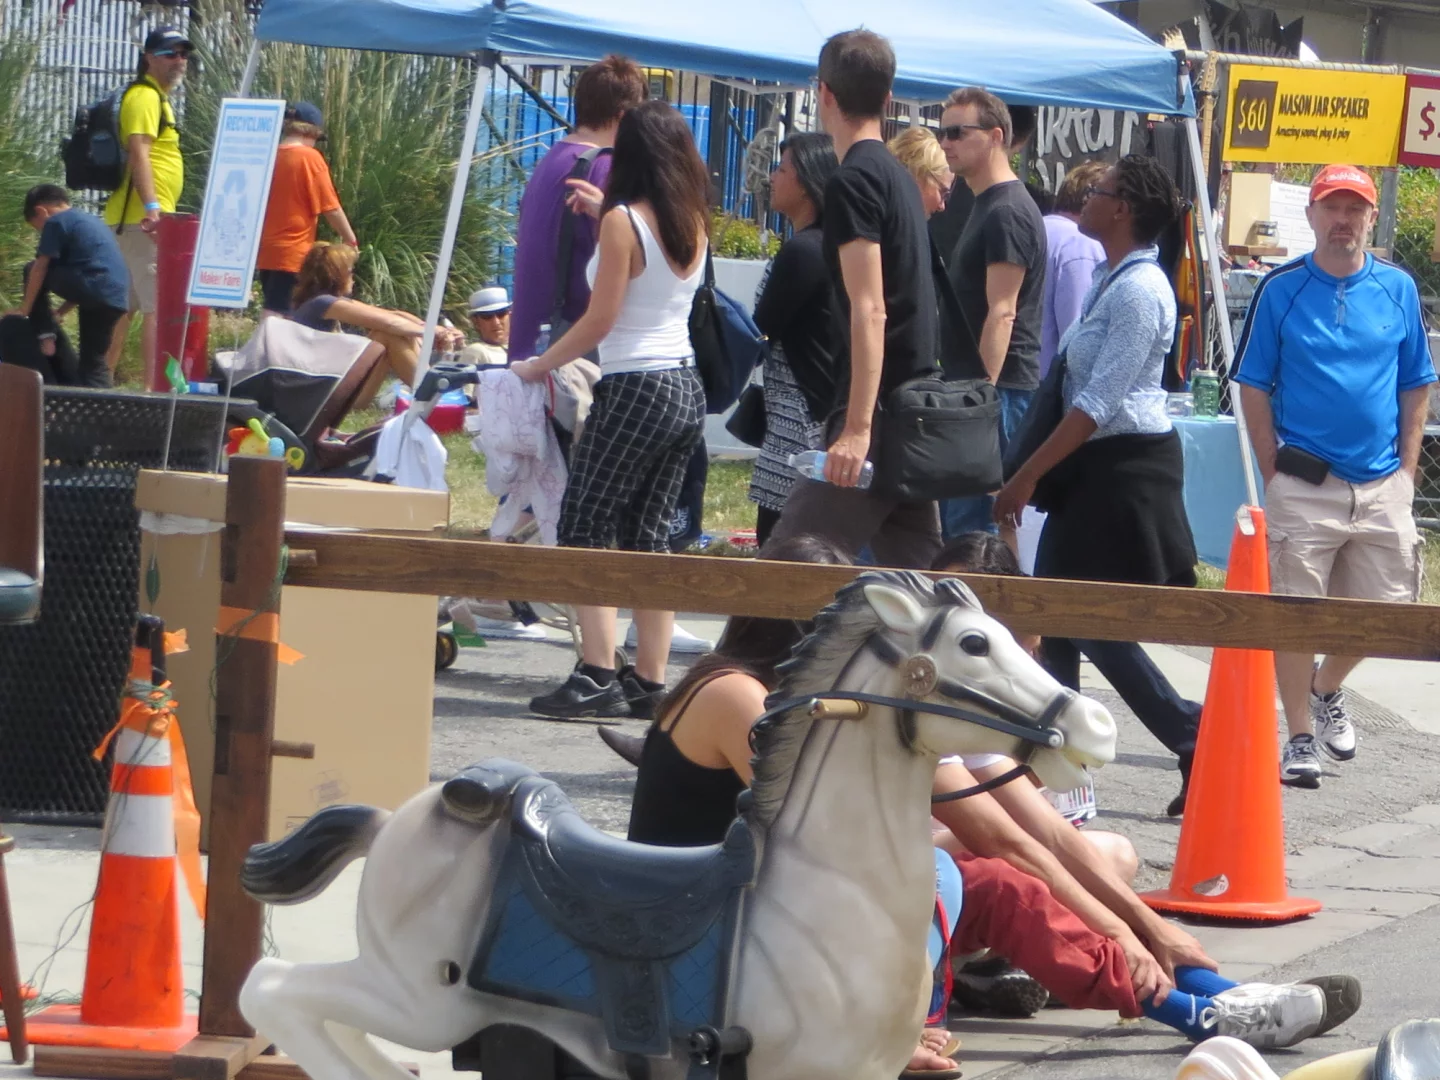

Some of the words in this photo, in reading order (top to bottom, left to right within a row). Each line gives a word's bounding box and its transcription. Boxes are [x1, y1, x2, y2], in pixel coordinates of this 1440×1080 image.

[1238, 97, 1268, 134] $60
[1278, 94, 1312, 116] MASON
[1311, 95, 1331, 118] JAR
[1330, 96, 1370, 120] SPEAKER
[225, 116, 273, 132] RECYCLING
